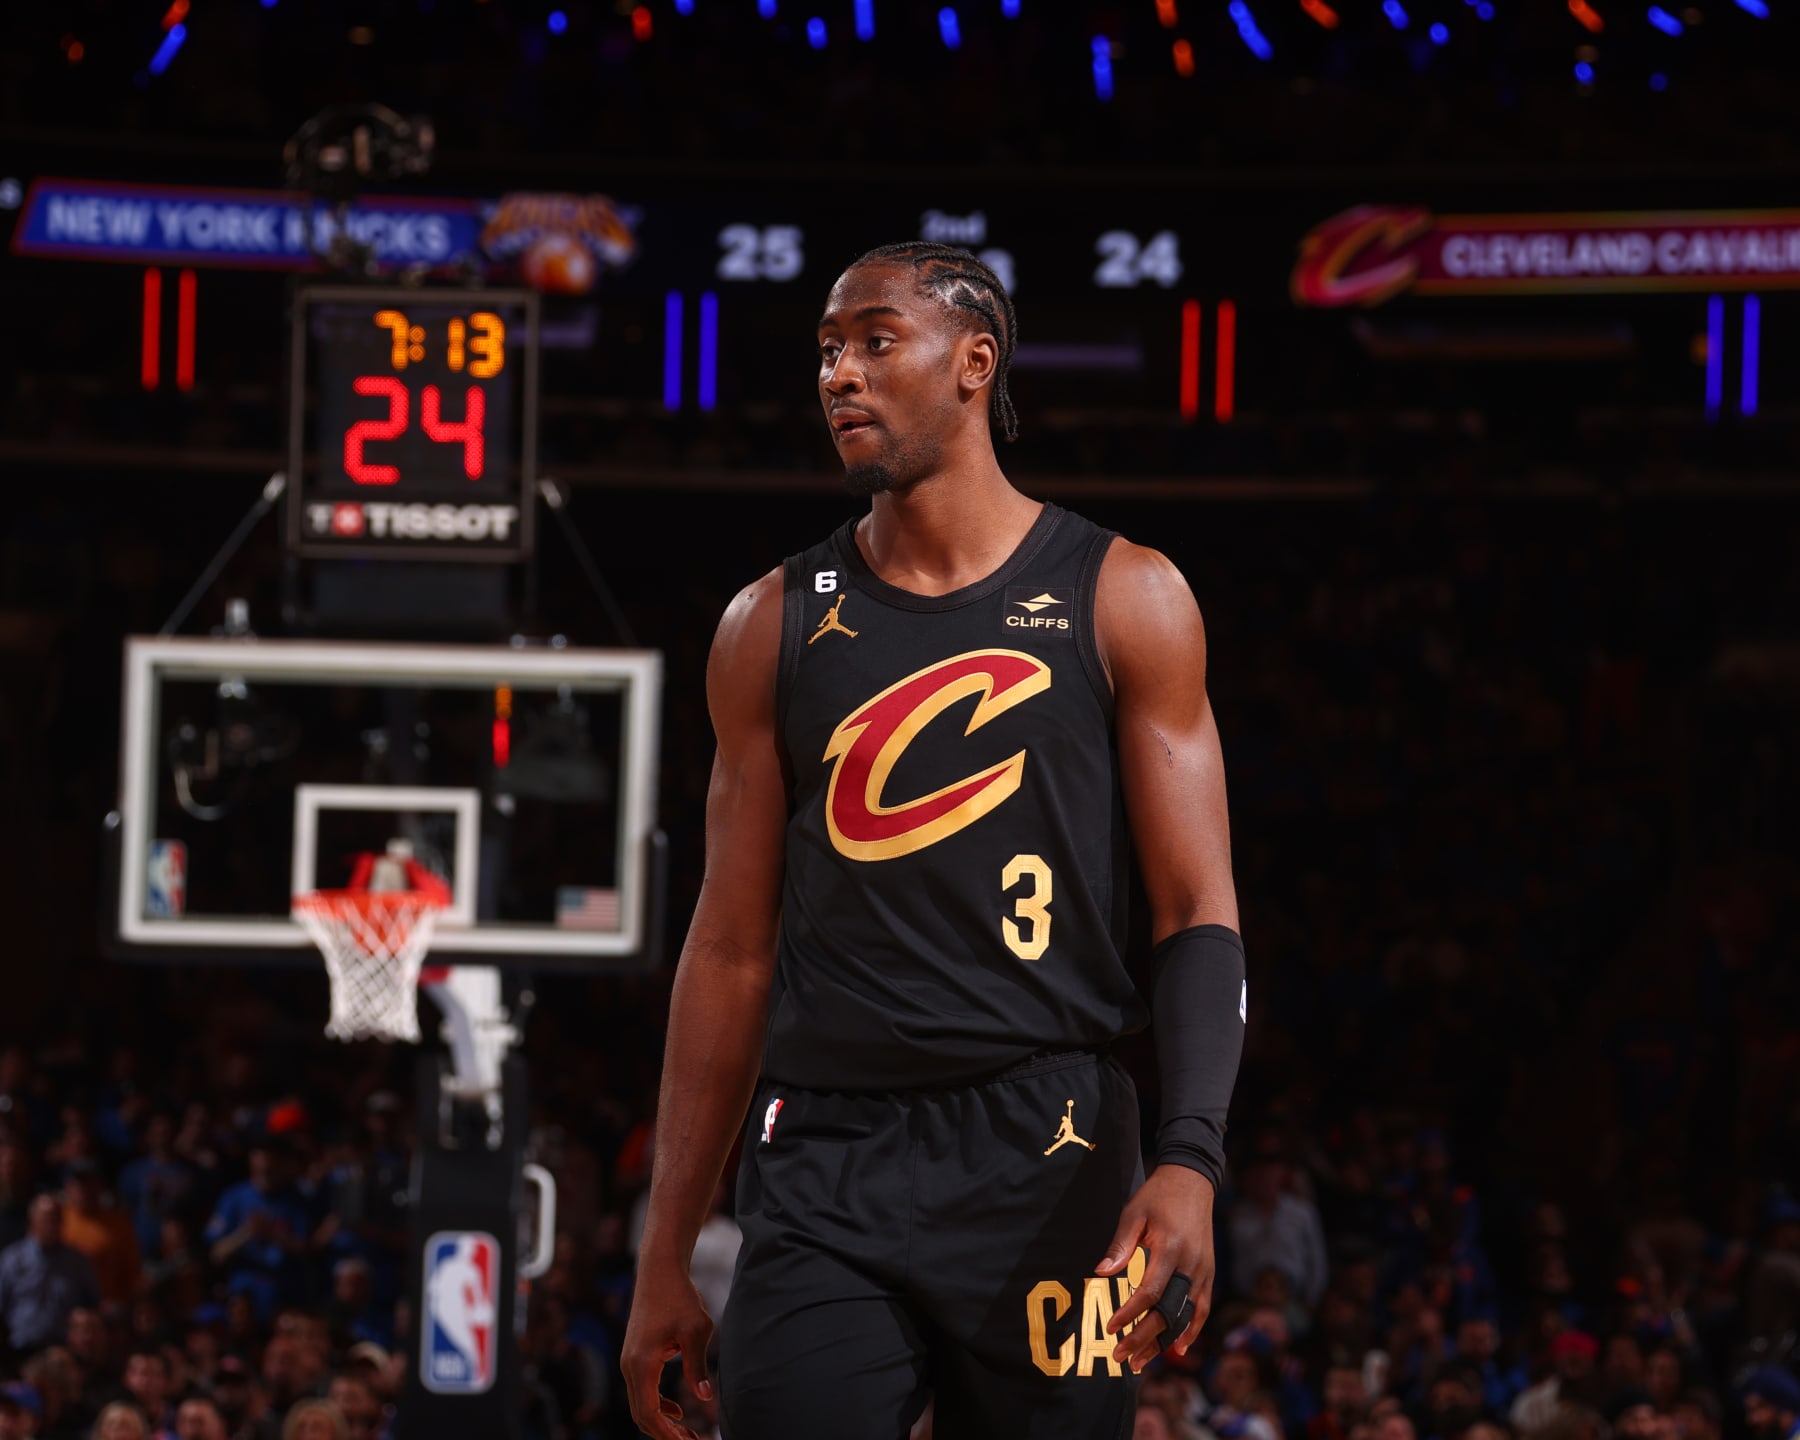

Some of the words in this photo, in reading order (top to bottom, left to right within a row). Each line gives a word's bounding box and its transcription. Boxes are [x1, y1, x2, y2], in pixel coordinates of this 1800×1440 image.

[47, 196, 152, 245] NEW
[157, 202, 279, 248] YORK
[921, 211, 986, 244] 2nd
[717, 224, 803, 281] 25
[1094, 231, 1182, 287] 24
[1441, 233, 1652, 275] CLEVELAND
[373, 310, 505, 378] 7:13
[344, 376, 486, 485] 24
[367, 502, 518, 540] TISSOT
[815, 570, 837, 593] 6
[1005, 615, 1069, 630] CLIFFS
[1002, 854, 1053, 960] 3
